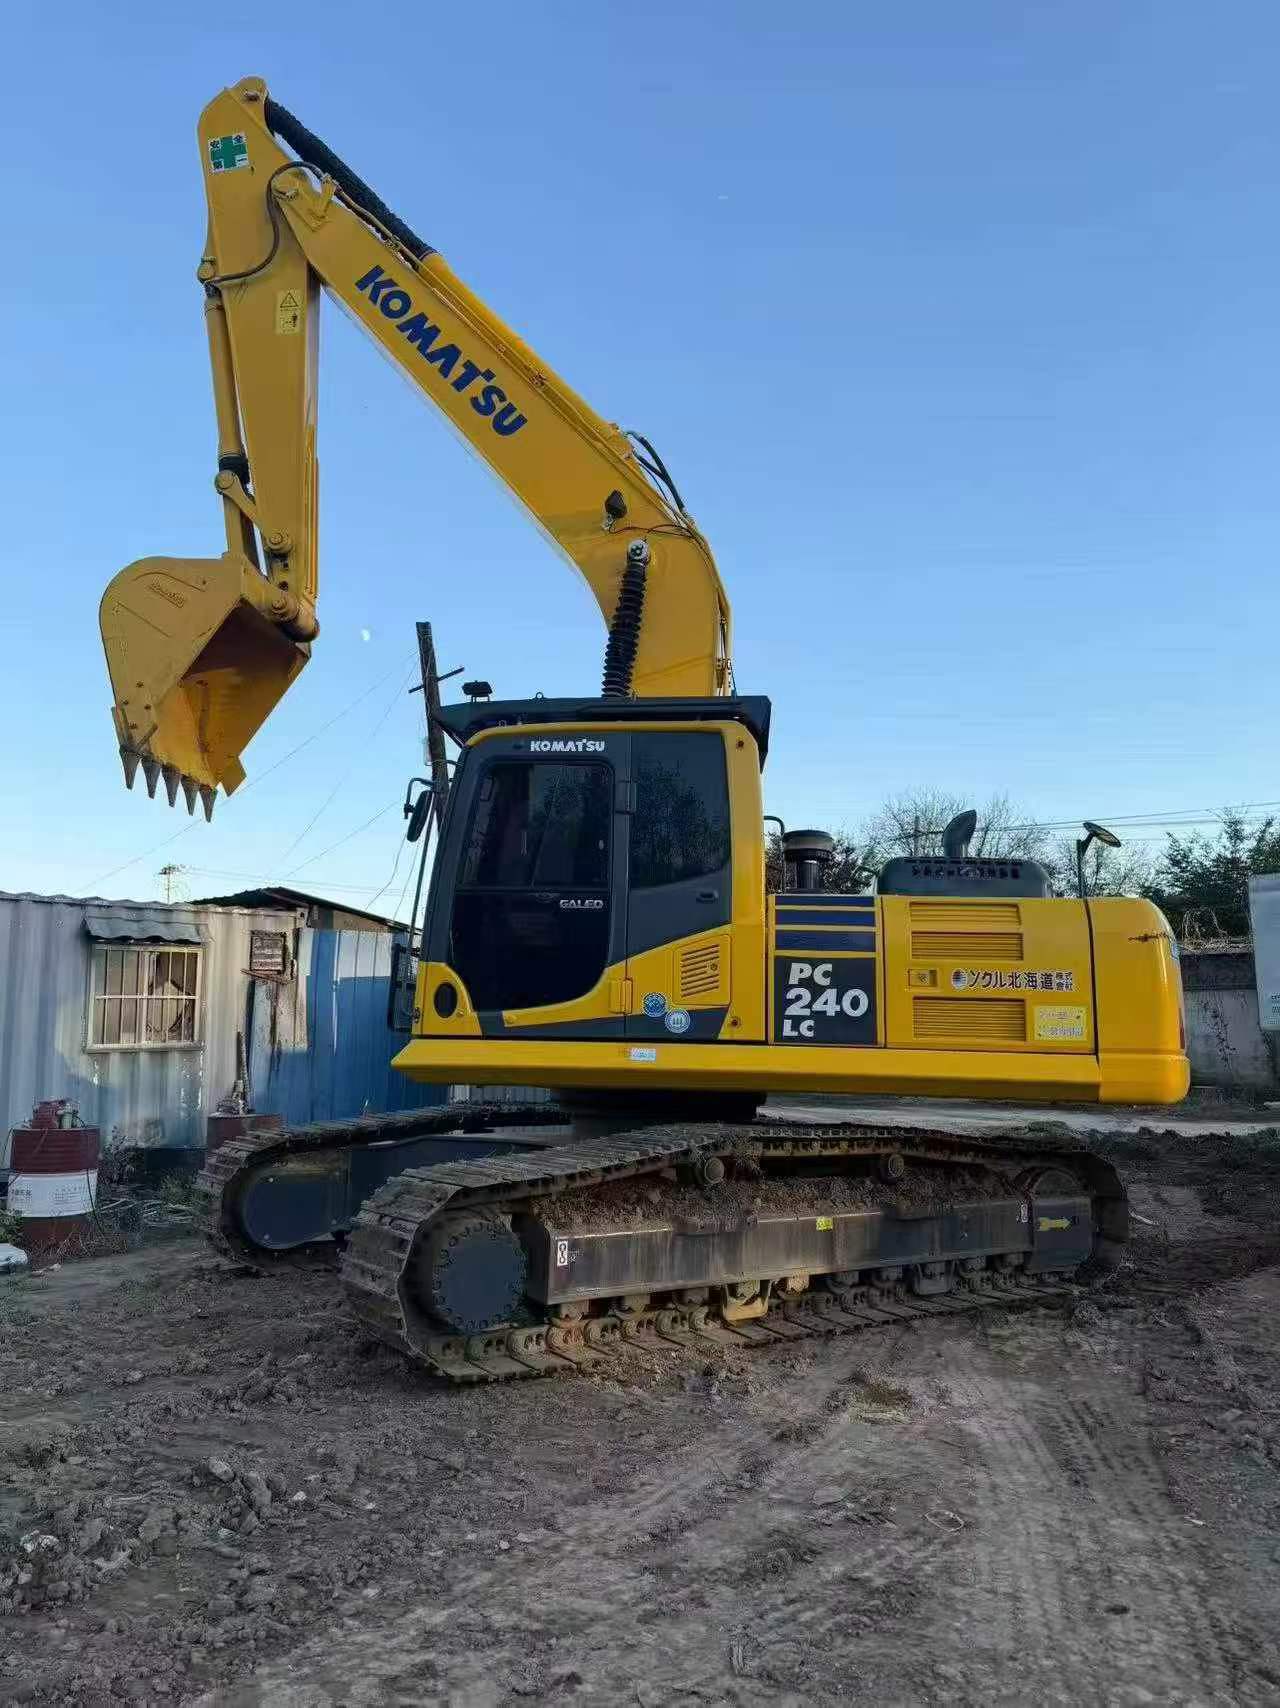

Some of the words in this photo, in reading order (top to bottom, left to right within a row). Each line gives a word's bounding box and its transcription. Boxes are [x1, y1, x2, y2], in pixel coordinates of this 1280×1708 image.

[355, 265, 528, 436] KOMATSU
[530, 739, 605, 752] KOMATSU
[788, 962, 833, 986] PC
[784, 987, 869, 1017] 240
[782, 1019, 815, 1037] LC
